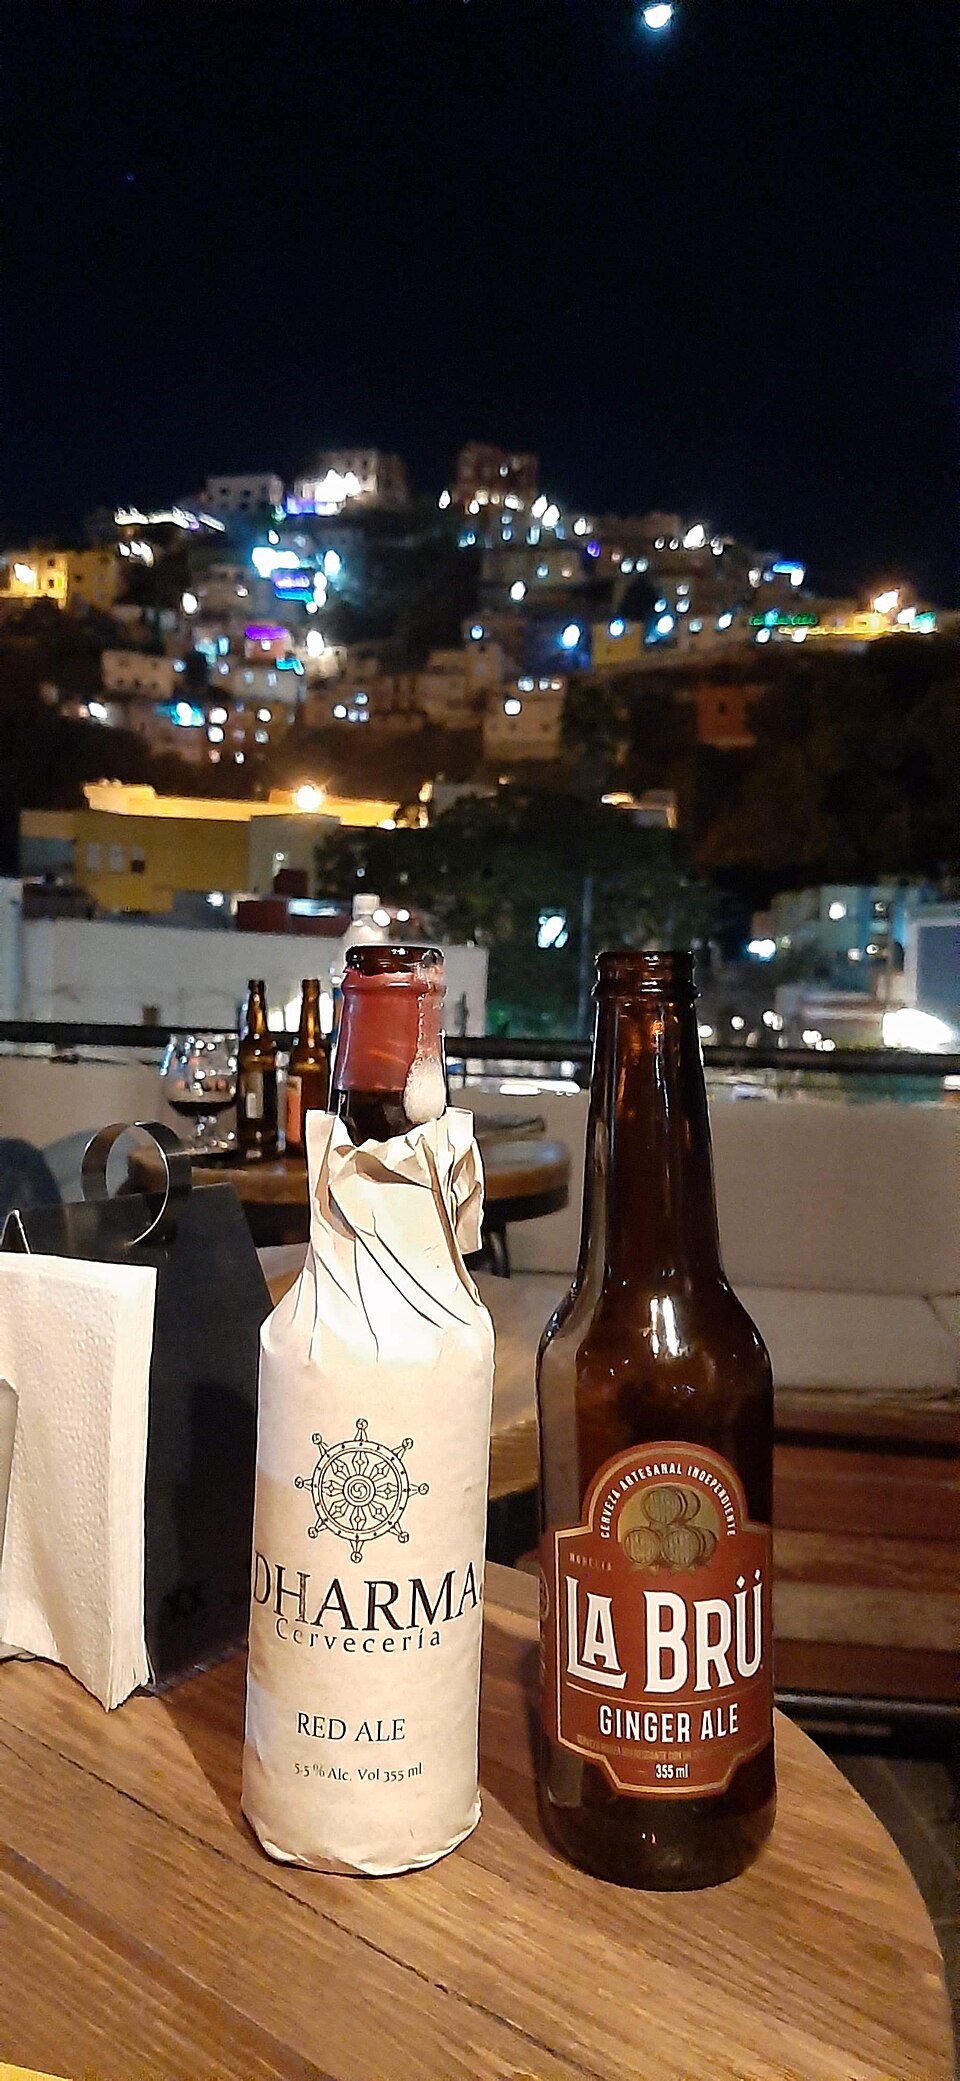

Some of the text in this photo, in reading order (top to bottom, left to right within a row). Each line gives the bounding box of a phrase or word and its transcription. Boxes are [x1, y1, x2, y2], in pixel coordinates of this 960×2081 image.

[600, 1462, 736, 1539] CERVEZA ARTESANAL INDEPENDIENTE
[253, 1552, 479, 1631] DHARMA
[276, 1617, 441, 1653] Cervecería
[566, 1569, 763, 1693] LA BRÜ
[297, 1712, 406, 1742] RED ALE
[600, 1703, 739, 1744] GINGER ALE
[328, 1767, 352, 1781] Alc.
[358, 1768, 380, 1781] Vol
[383, 1769, 404, 1782] 355
[408, 1762, 422, 1778] ml
[655, 1763, 688, 1779] 355 ml
